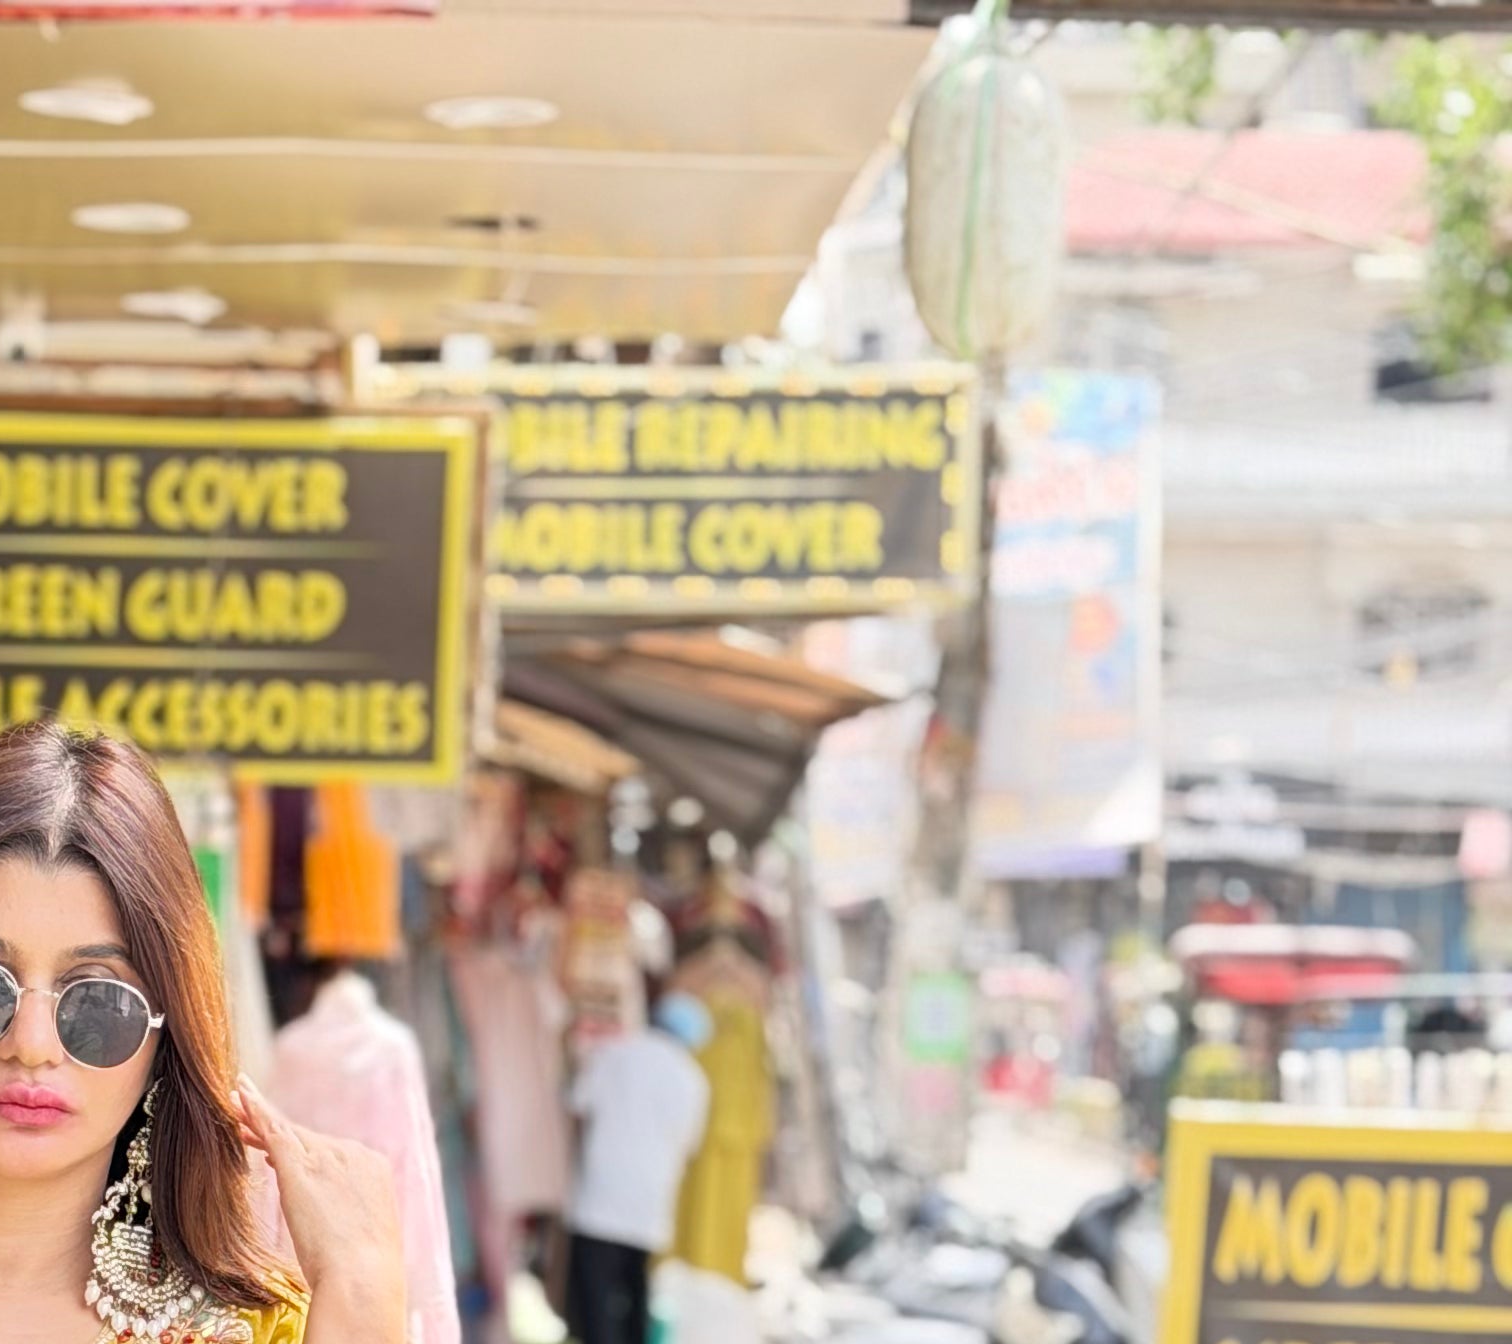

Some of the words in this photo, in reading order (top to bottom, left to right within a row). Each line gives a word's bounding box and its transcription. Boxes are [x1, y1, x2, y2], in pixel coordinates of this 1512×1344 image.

[507, 401, 629, 475] BILE
[634, 399, 946, 472] REPAIRING
[146, 457, 349, 532] COVER
[689, 503, 884, 574] COVER
[125, 569, 347, 641] GUARD
[58, 678, 431, 753] ACCESSORIES
[1213, 1171, 1489, 1294] MOBILE
